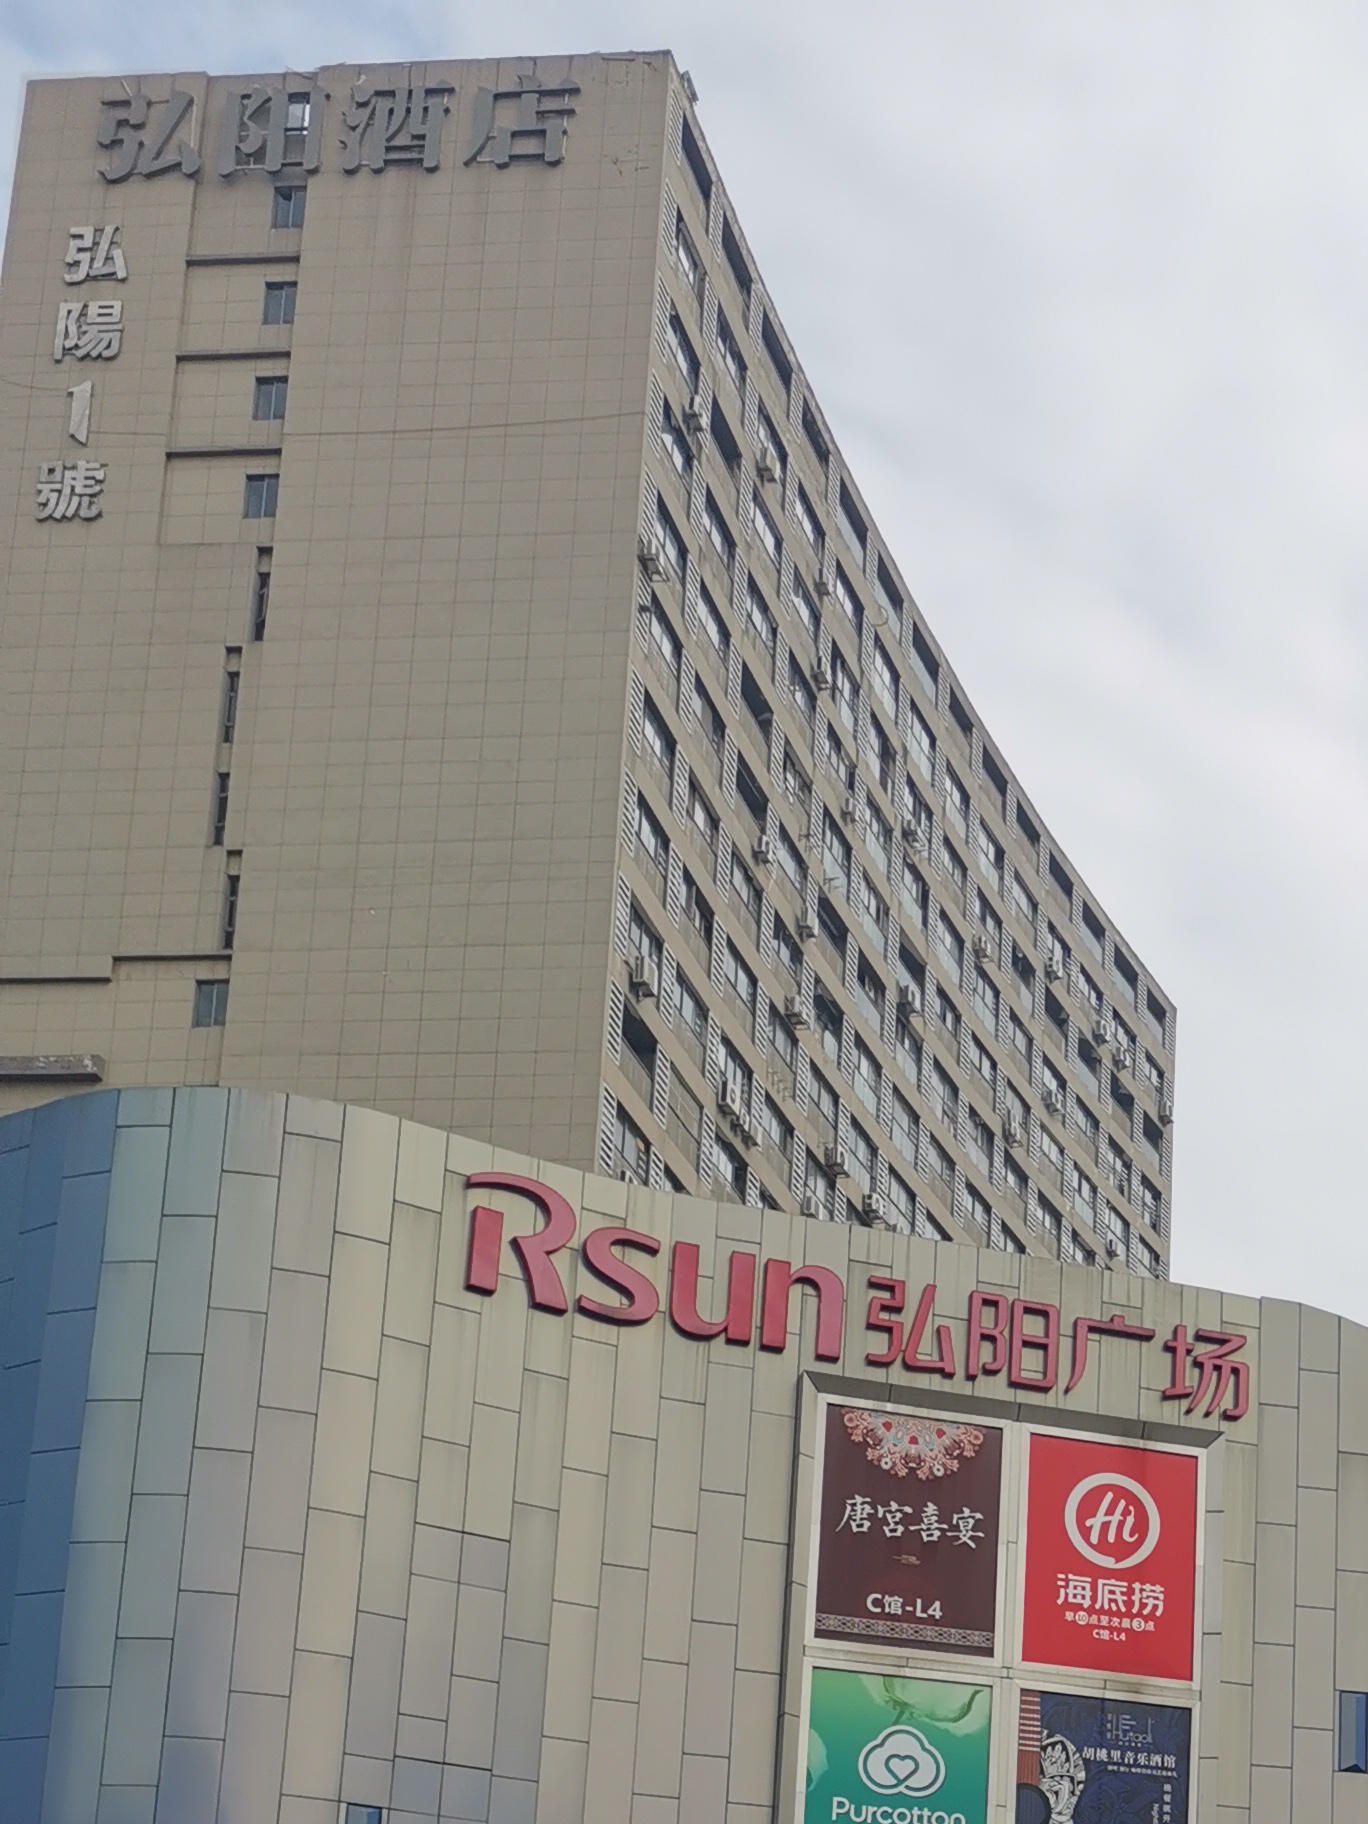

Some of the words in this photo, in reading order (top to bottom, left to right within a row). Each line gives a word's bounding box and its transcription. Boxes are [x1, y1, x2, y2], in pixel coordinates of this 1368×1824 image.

[97, 74, 581, 183] 弘阳酒店
[465, 1171, 845, 1362] Rsun
[865, 1274, 1252, 1420] 弘阳广场
[1085, 1491, 1139, 1545] Hi
[866, 1593, 943, 1619] C馆-L4
[1056, 1573, 1165, 1617] 海底捞
[1082, 1746, 1176, 1769] 胡桃里音乐酒馆
